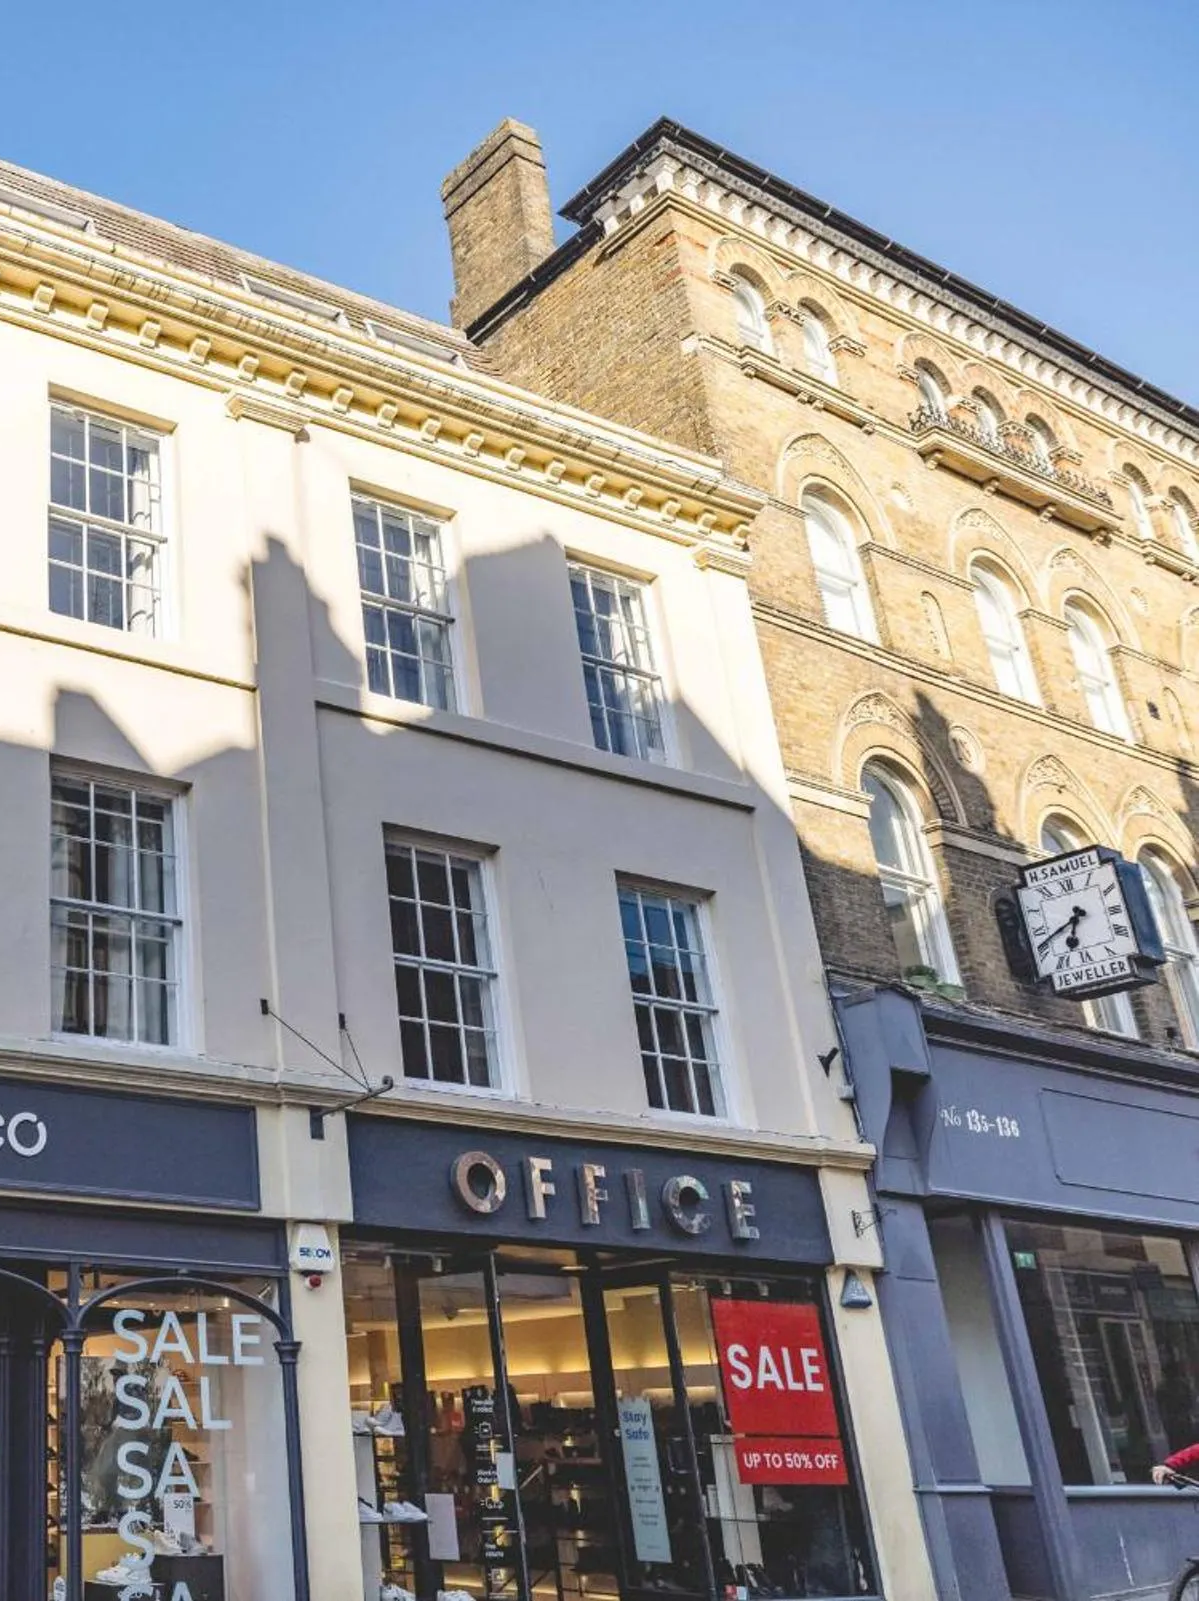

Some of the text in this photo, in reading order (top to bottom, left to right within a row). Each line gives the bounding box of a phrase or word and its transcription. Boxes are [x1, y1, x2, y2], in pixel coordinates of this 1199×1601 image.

[1058, 960, 1127, 987] JEWELLER
[451, 1151, 760, 1240] OFFICE
[112, 1309, 264, 1365] SALE
[727, 1344, 824, 1392] SALE
[115, 1374, 233, 1430] SAL
[622, 1411, 647, 1425] Stay
[625, 1428, 649, 1441] Safe
[117, 1441, 201, 1499] SA
[743, 1453, 840, 1469] UP TO 50% OFF
